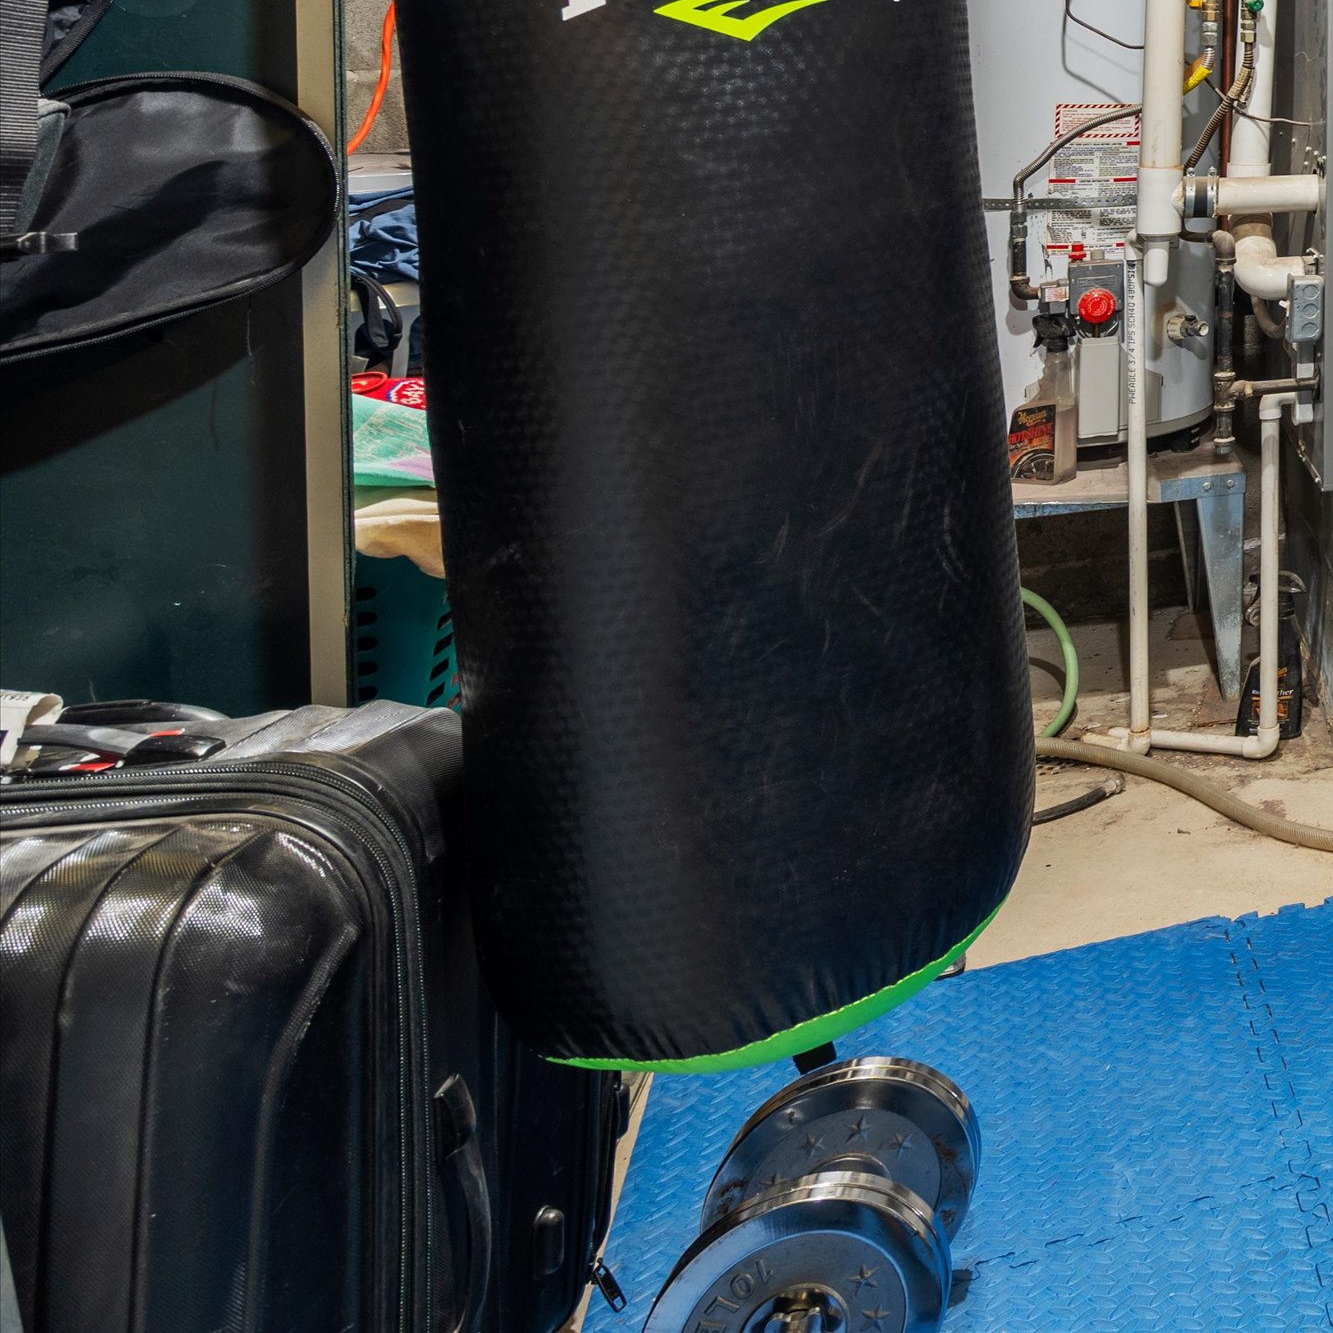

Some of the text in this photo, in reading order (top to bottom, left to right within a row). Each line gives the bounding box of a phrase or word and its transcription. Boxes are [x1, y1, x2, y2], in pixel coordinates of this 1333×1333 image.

[1127, 330, 1137, 346] IPS
[1127, 346, 1137, 367] 3/4
[729, 1258, 775, 1301] 10
